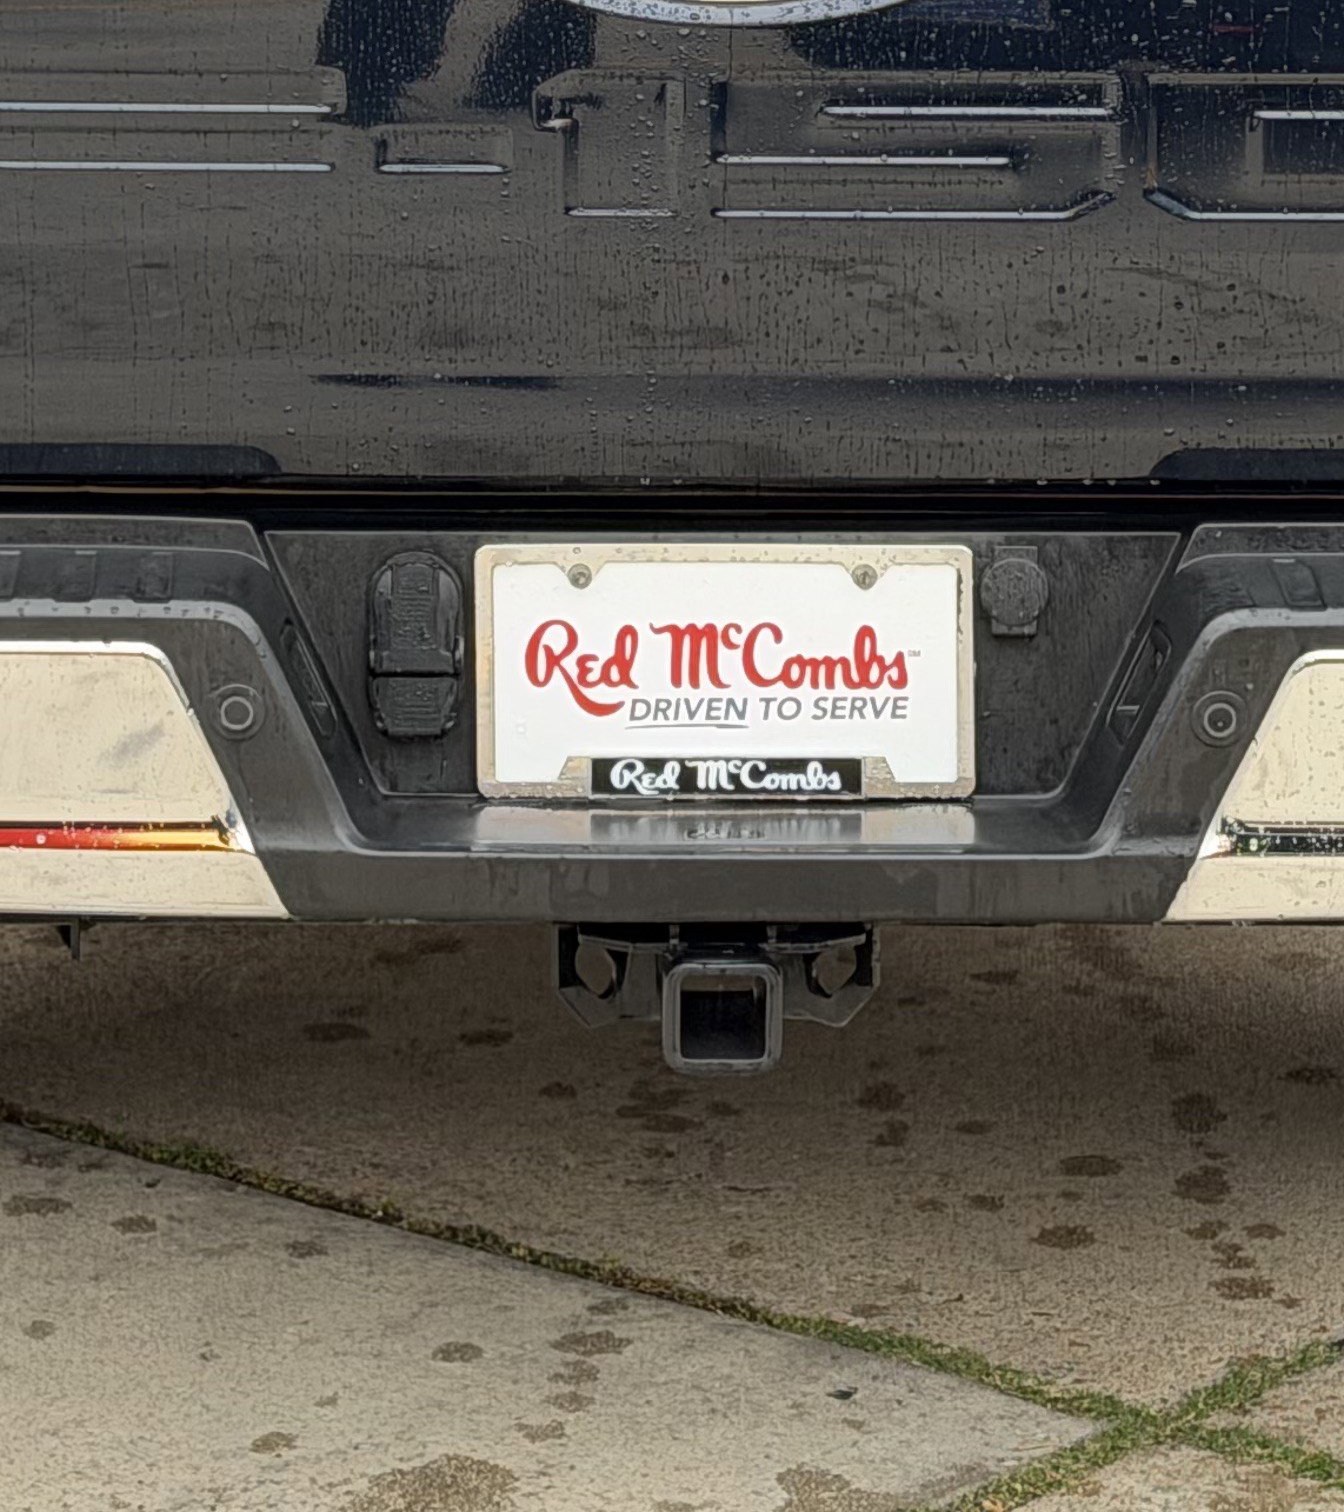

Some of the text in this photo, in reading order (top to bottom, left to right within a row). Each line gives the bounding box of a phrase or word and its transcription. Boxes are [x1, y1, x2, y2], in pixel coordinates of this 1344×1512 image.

[523, 619, 909, 718] Red McCombs
[628, 695, 910, 722] DRIVEN TO SERVE
[609, 758, 842, 795] Red McCombs
